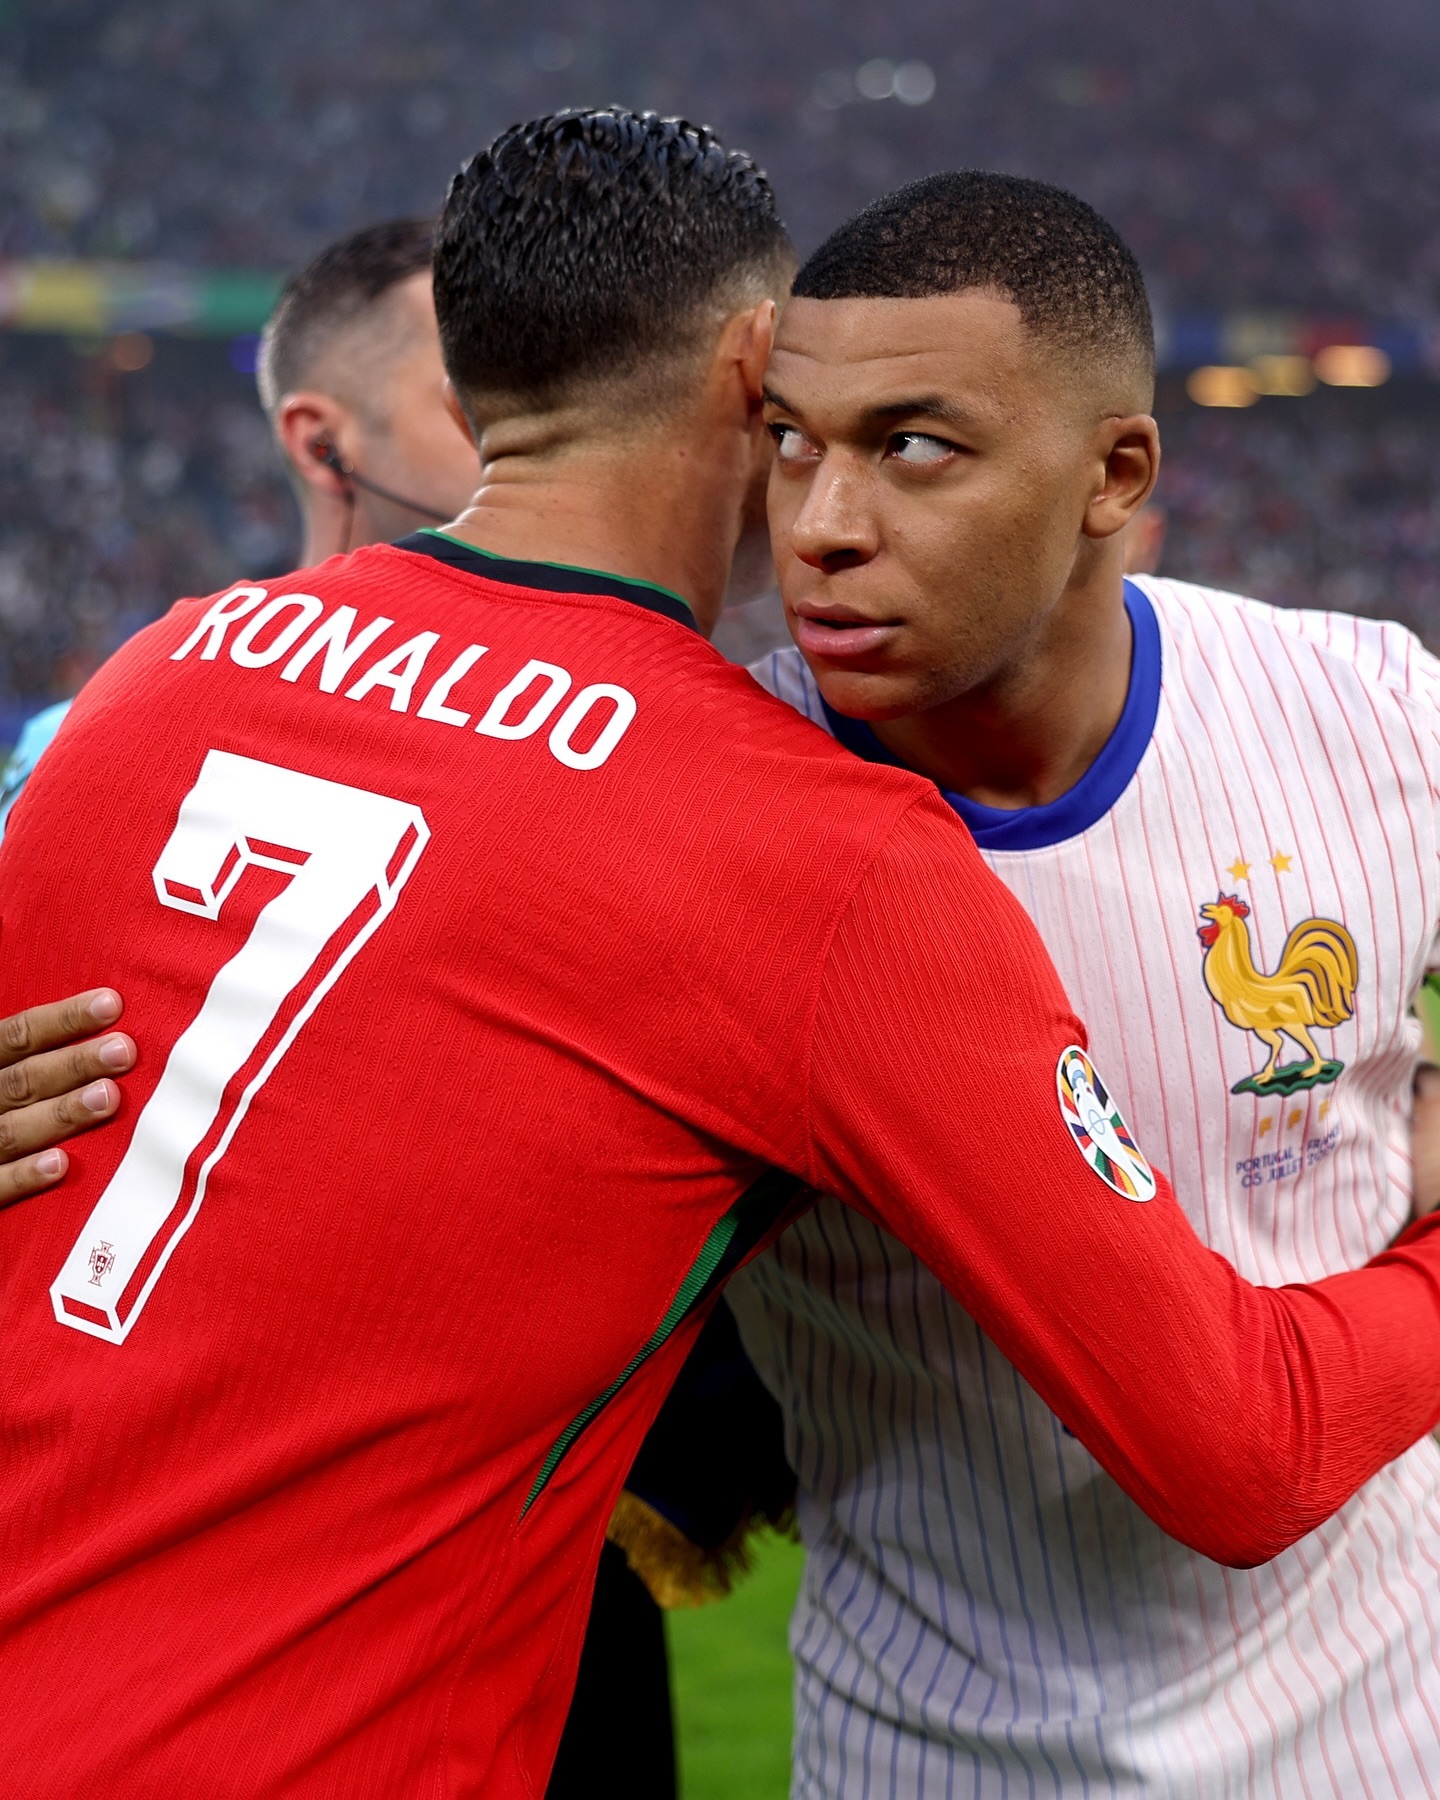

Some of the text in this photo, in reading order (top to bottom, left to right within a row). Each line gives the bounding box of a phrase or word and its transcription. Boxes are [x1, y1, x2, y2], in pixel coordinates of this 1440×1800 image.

[170, 587, 637, 771] RONALDO
[50, 749, 431, 1345] 7
[1235, 1147, 1294, 1175] PORTUGAL
[1241, 1172, 1263, 1189] 05
